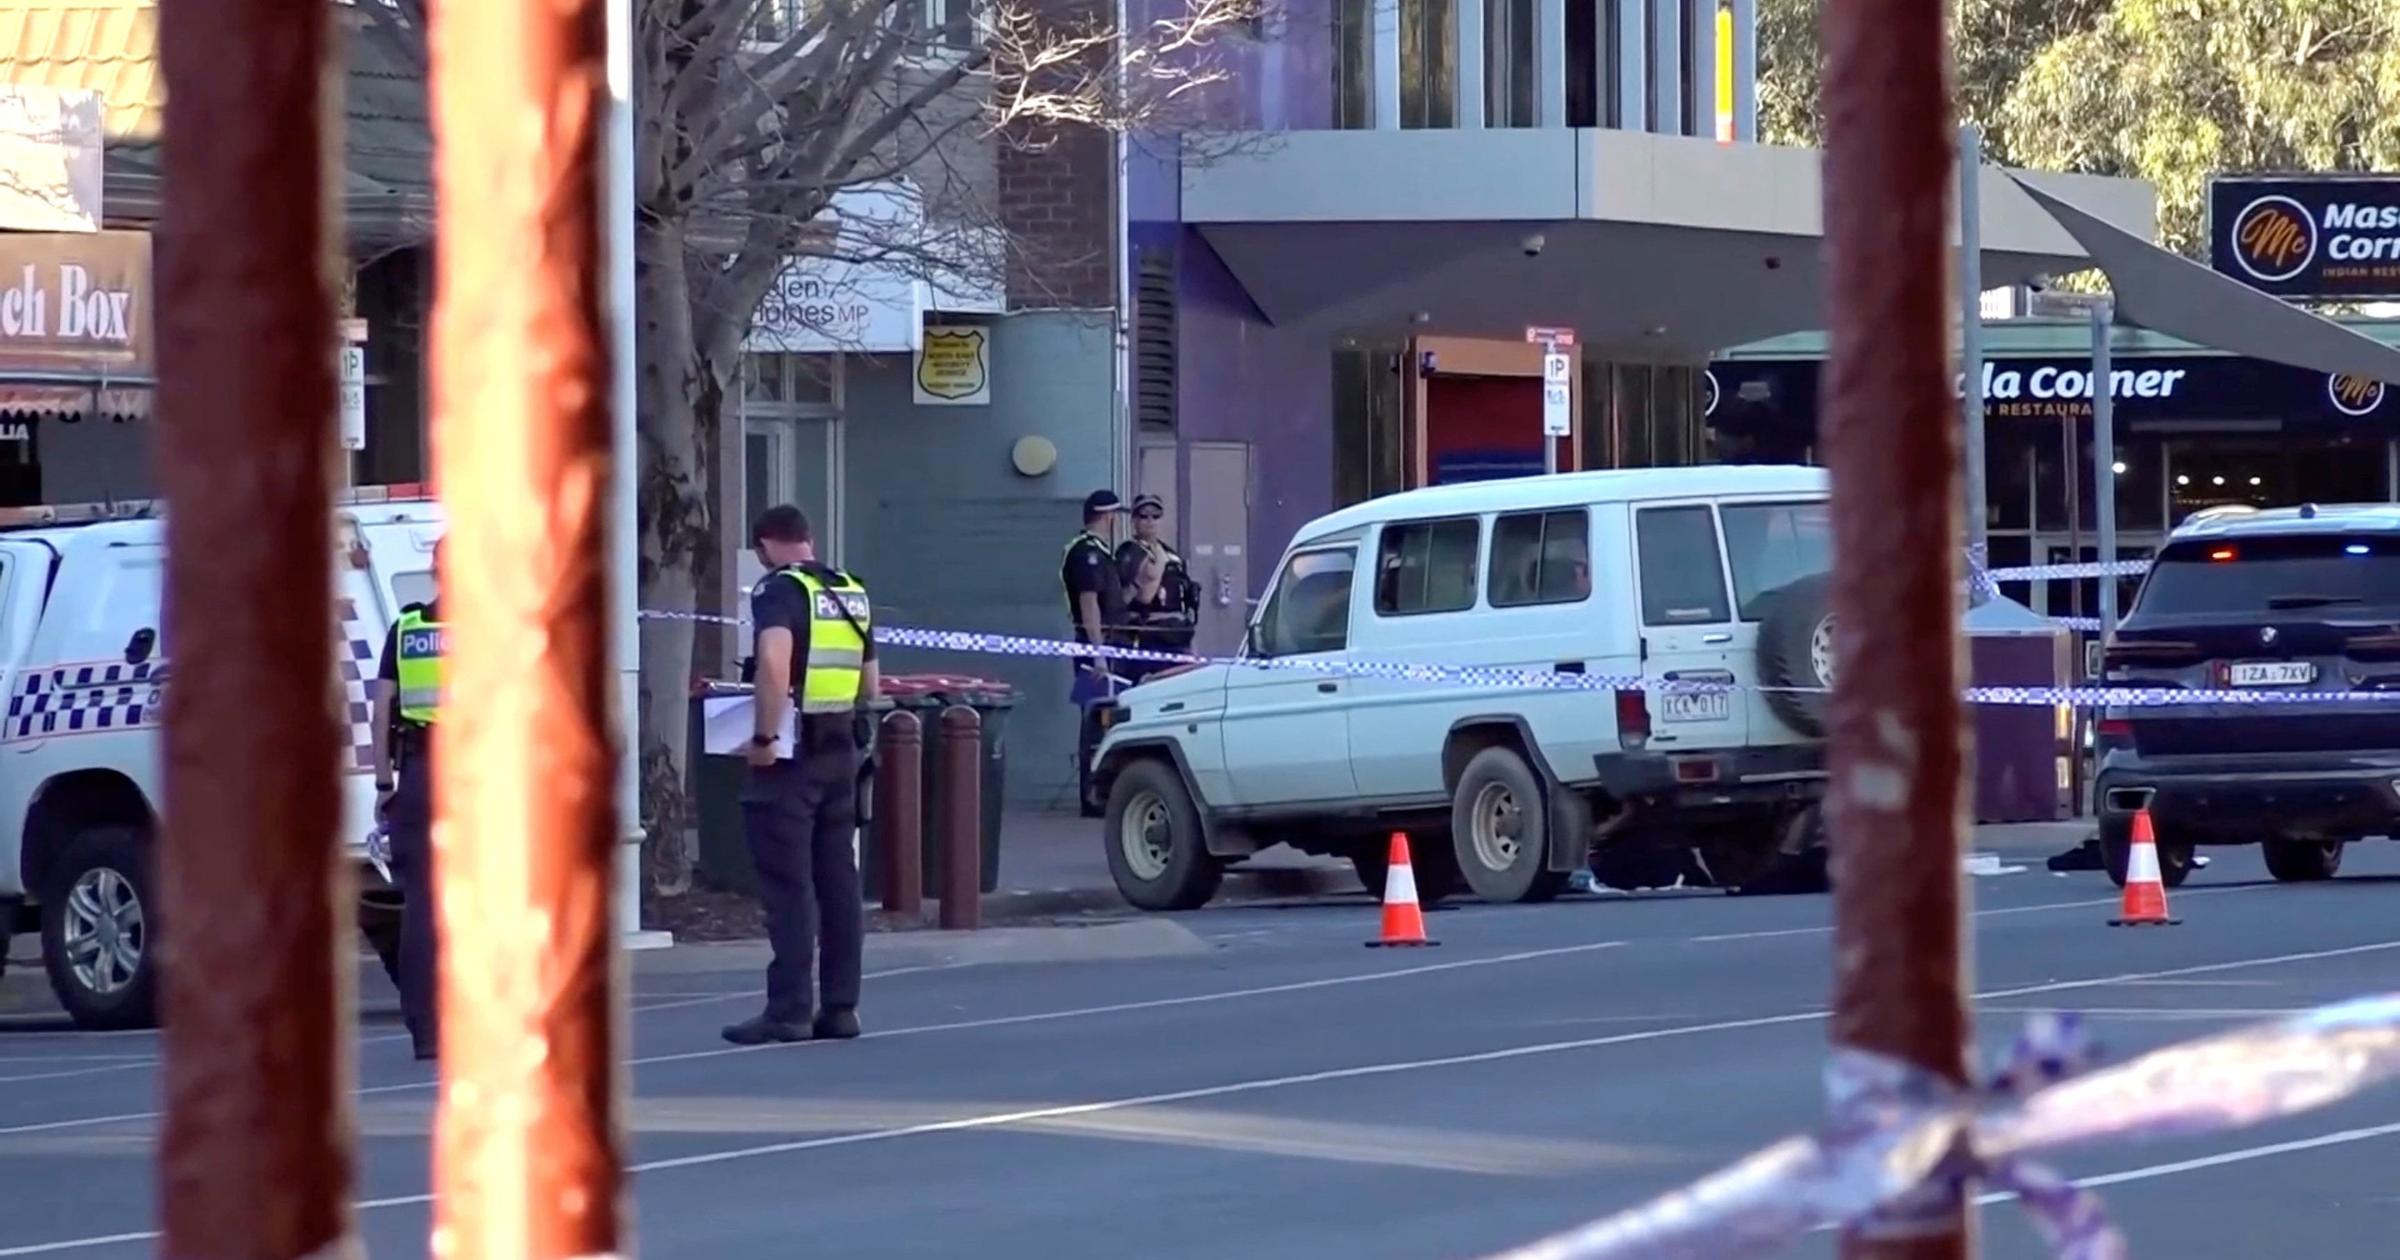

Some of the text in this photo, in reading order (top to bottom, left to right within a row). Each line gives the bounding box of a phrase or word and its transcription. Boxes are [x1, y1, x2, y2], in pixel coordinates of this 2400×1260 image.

[2323, 203, 2400, 229] Mas
[57, 263, 130, 341] Box
[839, 304, 869, 322] MP
[1999, 402, 2117, 417] RESTAURA
[816, 594, 867, 617] Poce
[403, 631, 450, 654] Polic
